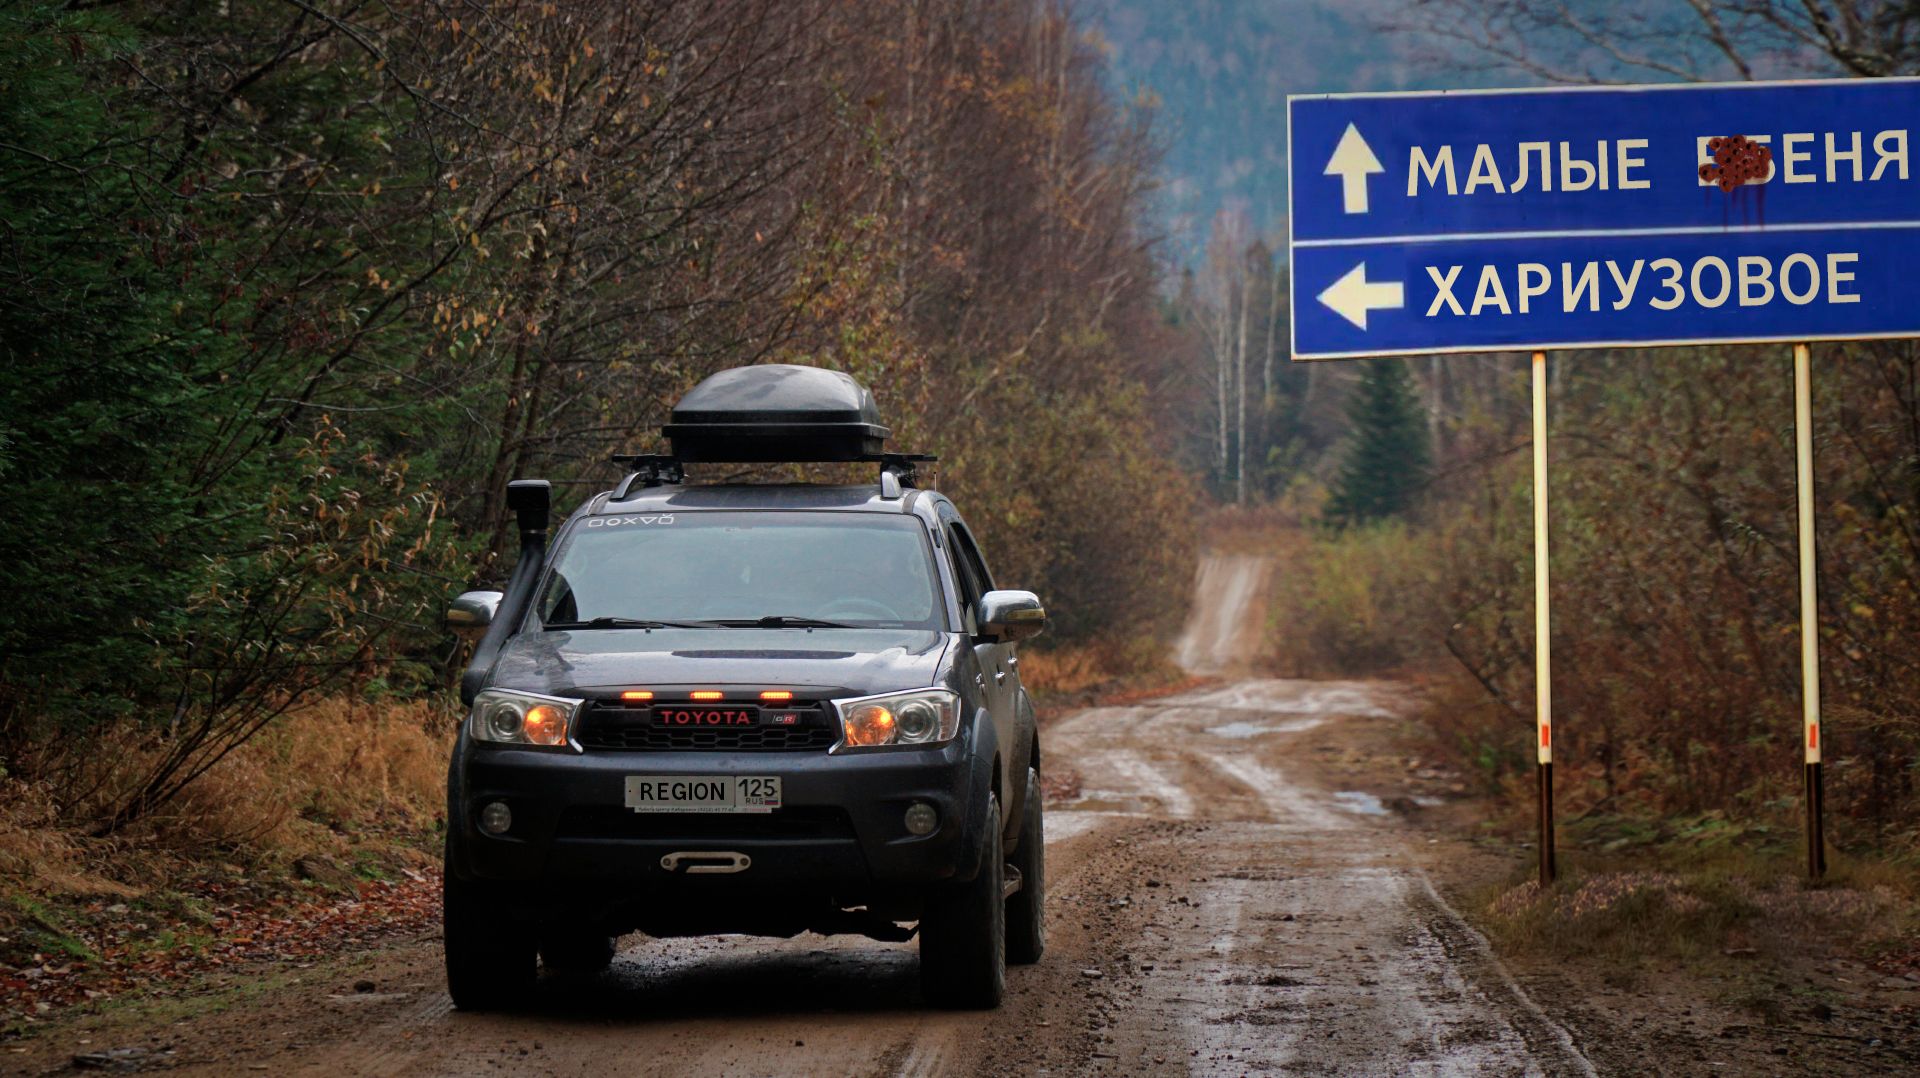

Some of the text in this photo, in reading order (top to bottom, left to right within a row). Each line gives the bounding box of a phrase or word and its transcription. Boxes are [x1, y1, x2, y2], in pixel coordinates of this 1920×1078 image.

[1407, 139, 1651, 197] МАЛЫЕ
[1425, 253, 1861, 317] ХАРИУЗОВОЕ
[660, 710, 751, 725] TOYOTA
[640, 779, 776, 801] REGION 125
[745, 797, 764, 805] RUS
